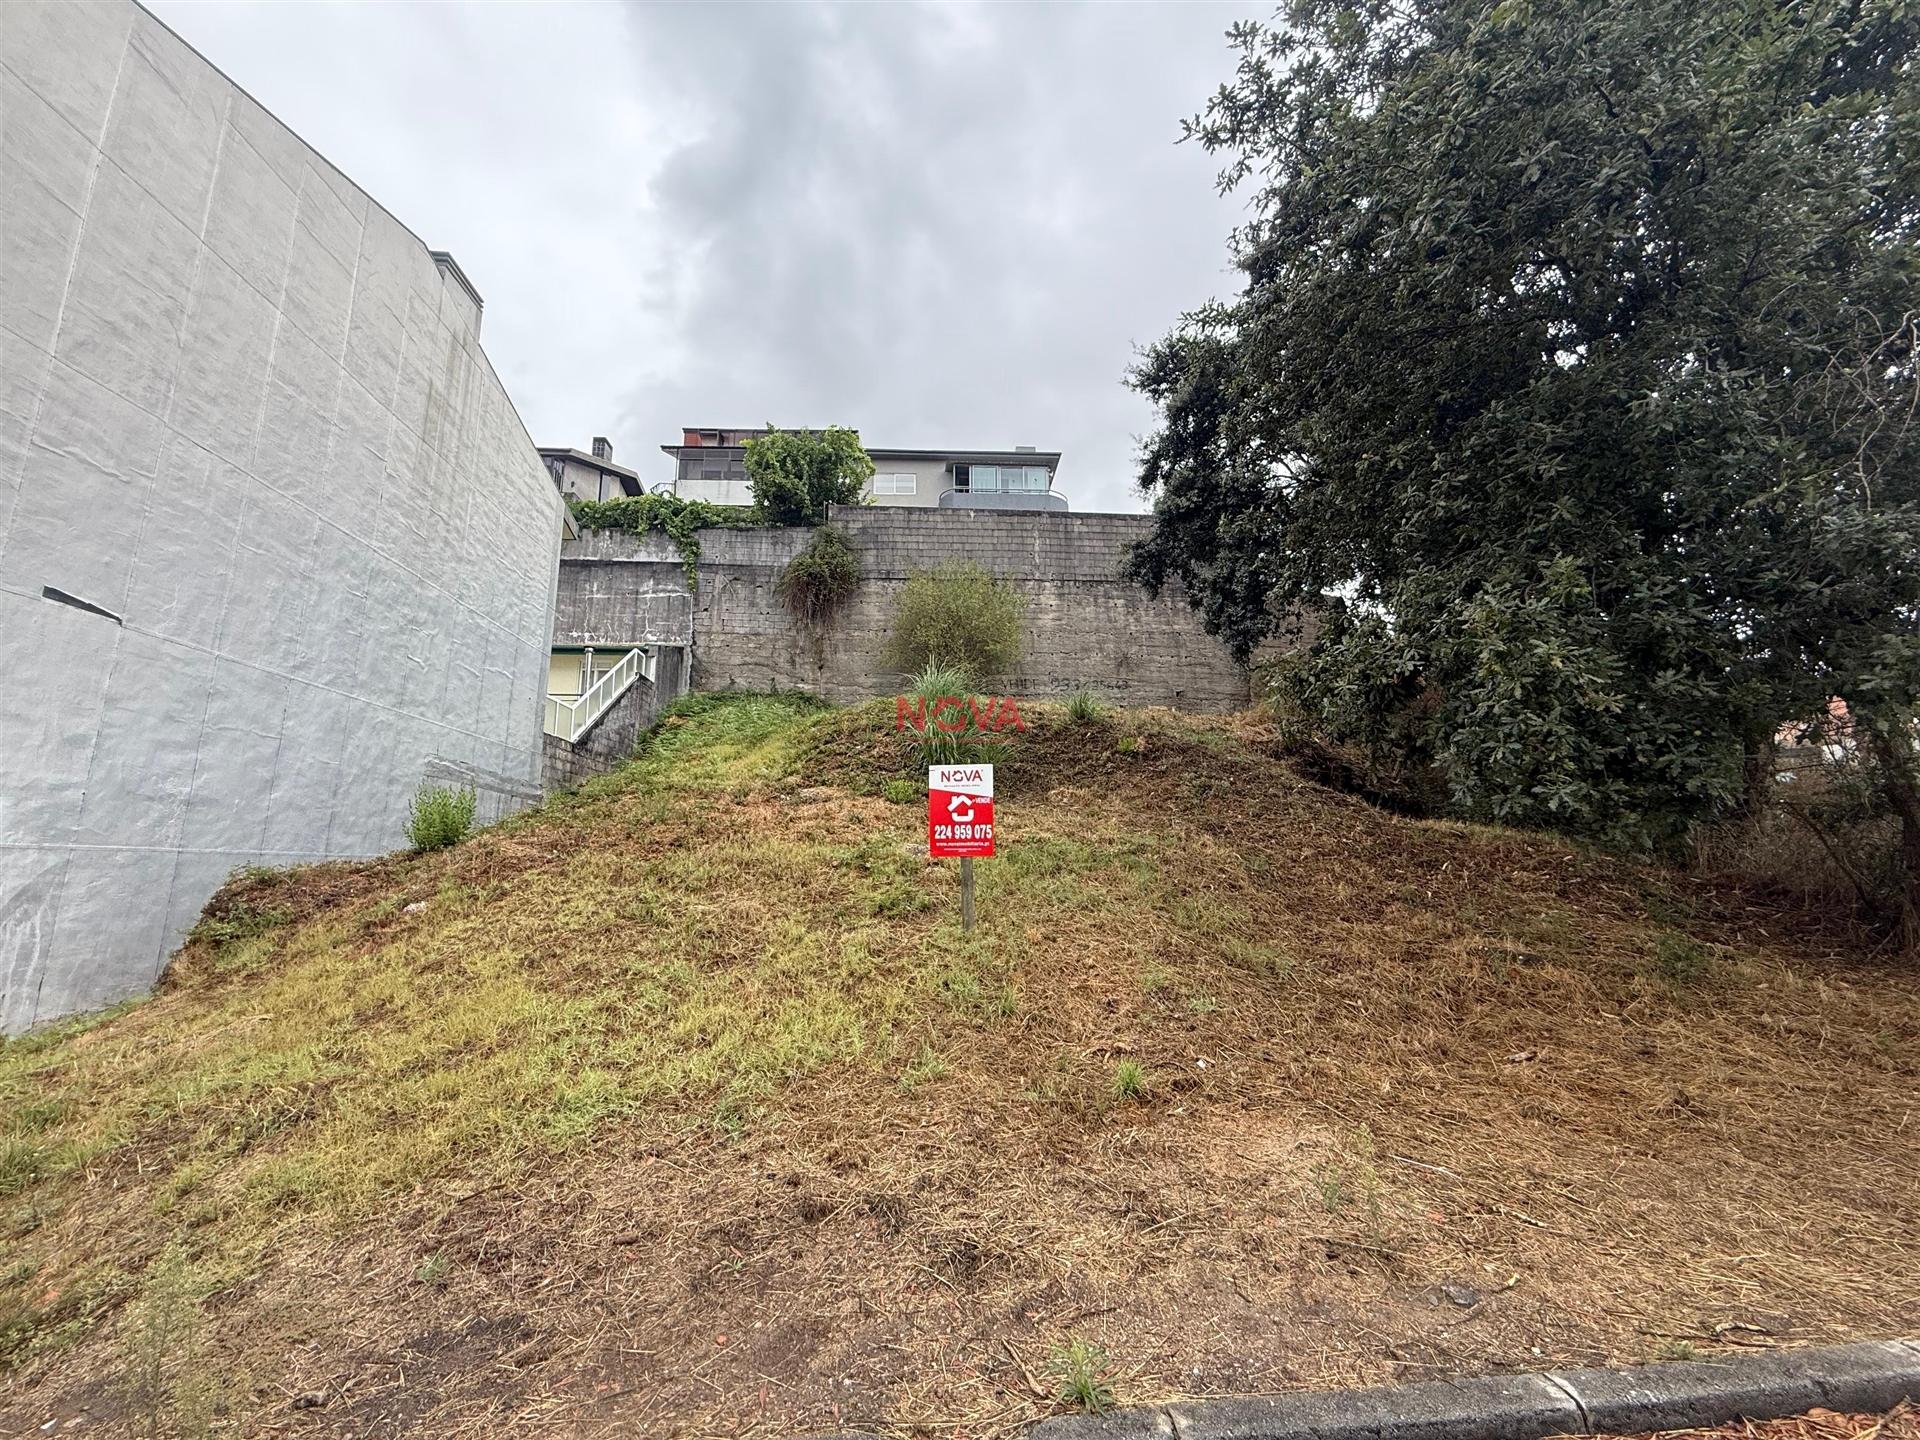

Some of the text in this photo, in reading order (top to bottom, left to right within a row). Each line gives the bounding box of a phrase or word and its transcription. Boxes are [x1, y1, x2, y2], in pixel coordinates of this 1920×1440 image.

[940, 769, 984, 783] NOVA
[934, 824, 993, 839] 224 959 075
